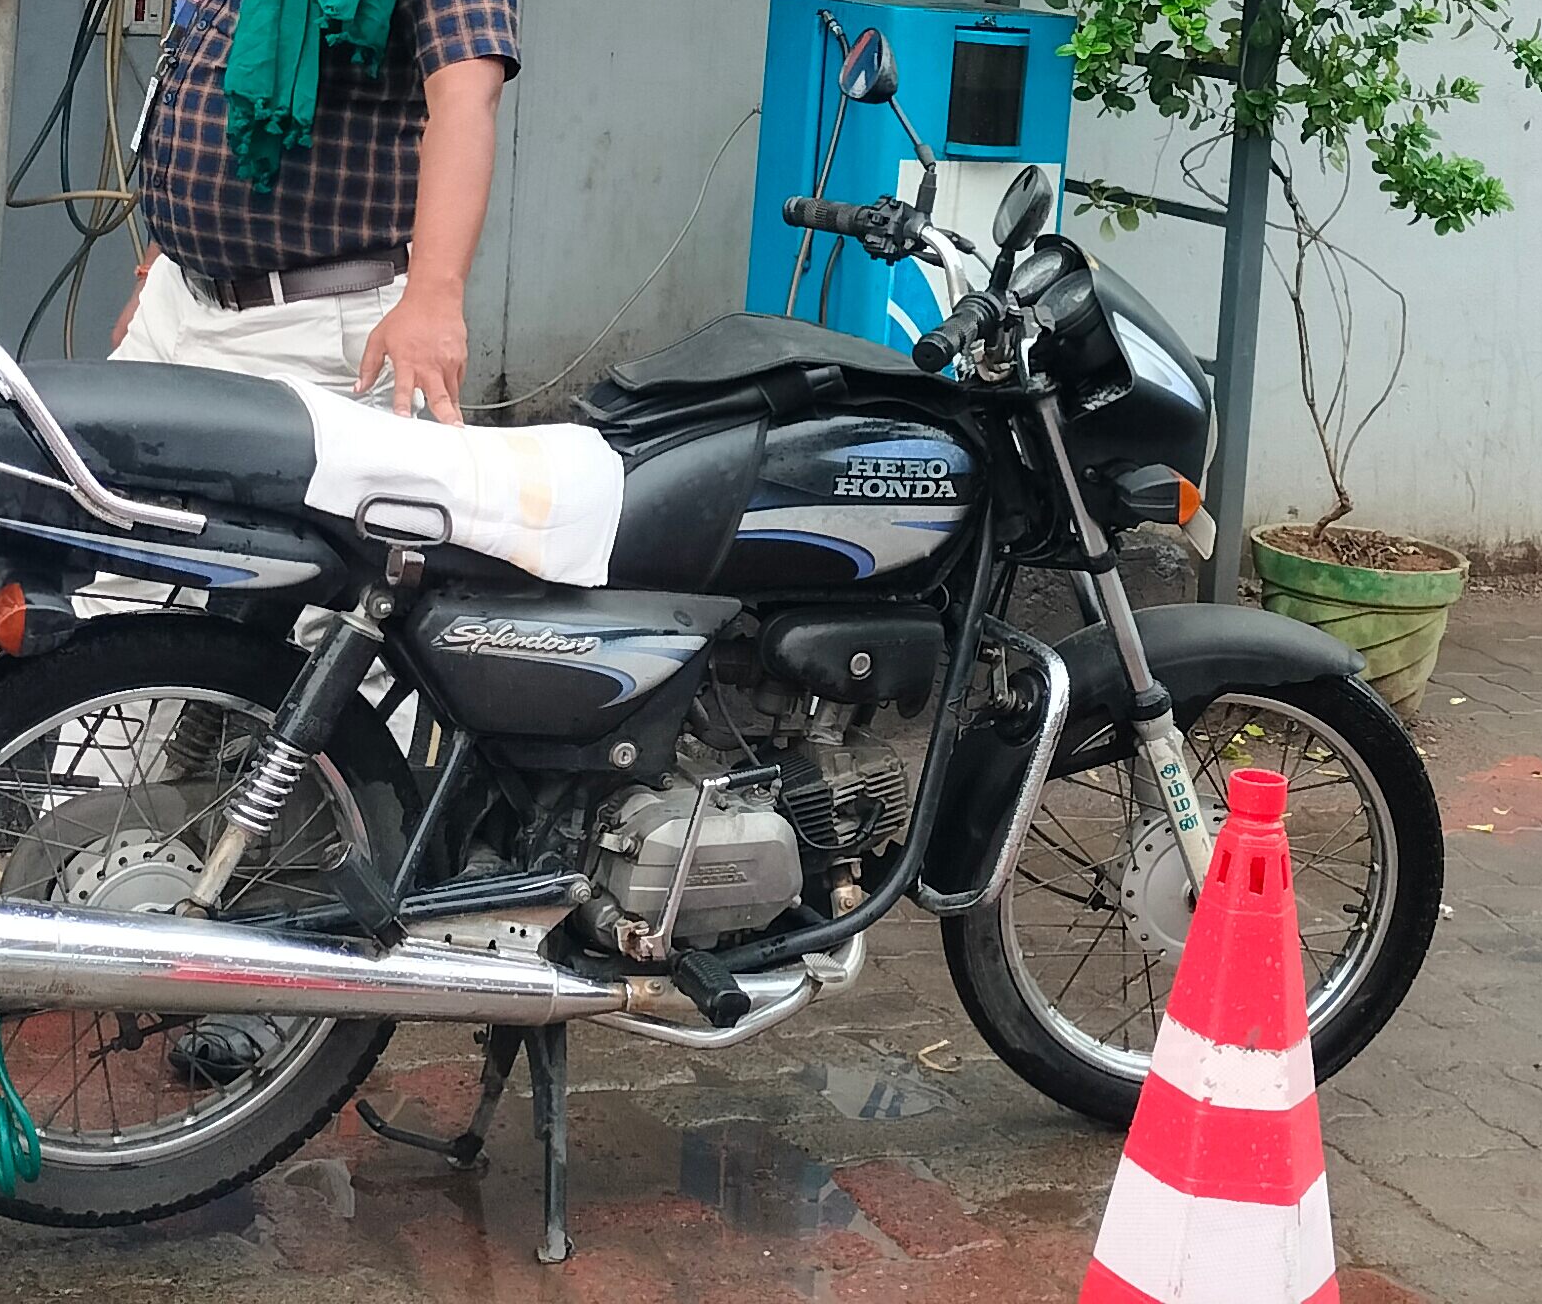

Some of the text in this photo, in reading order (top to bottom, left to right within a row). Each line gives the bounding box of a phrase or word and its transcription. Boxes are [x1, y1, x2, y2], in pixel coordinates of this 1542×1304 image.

[847, 457, 949, 479] HERO
[833, 477, 958, 499] HONDA
[1160, 762, 1199, 833] அம்மன்
